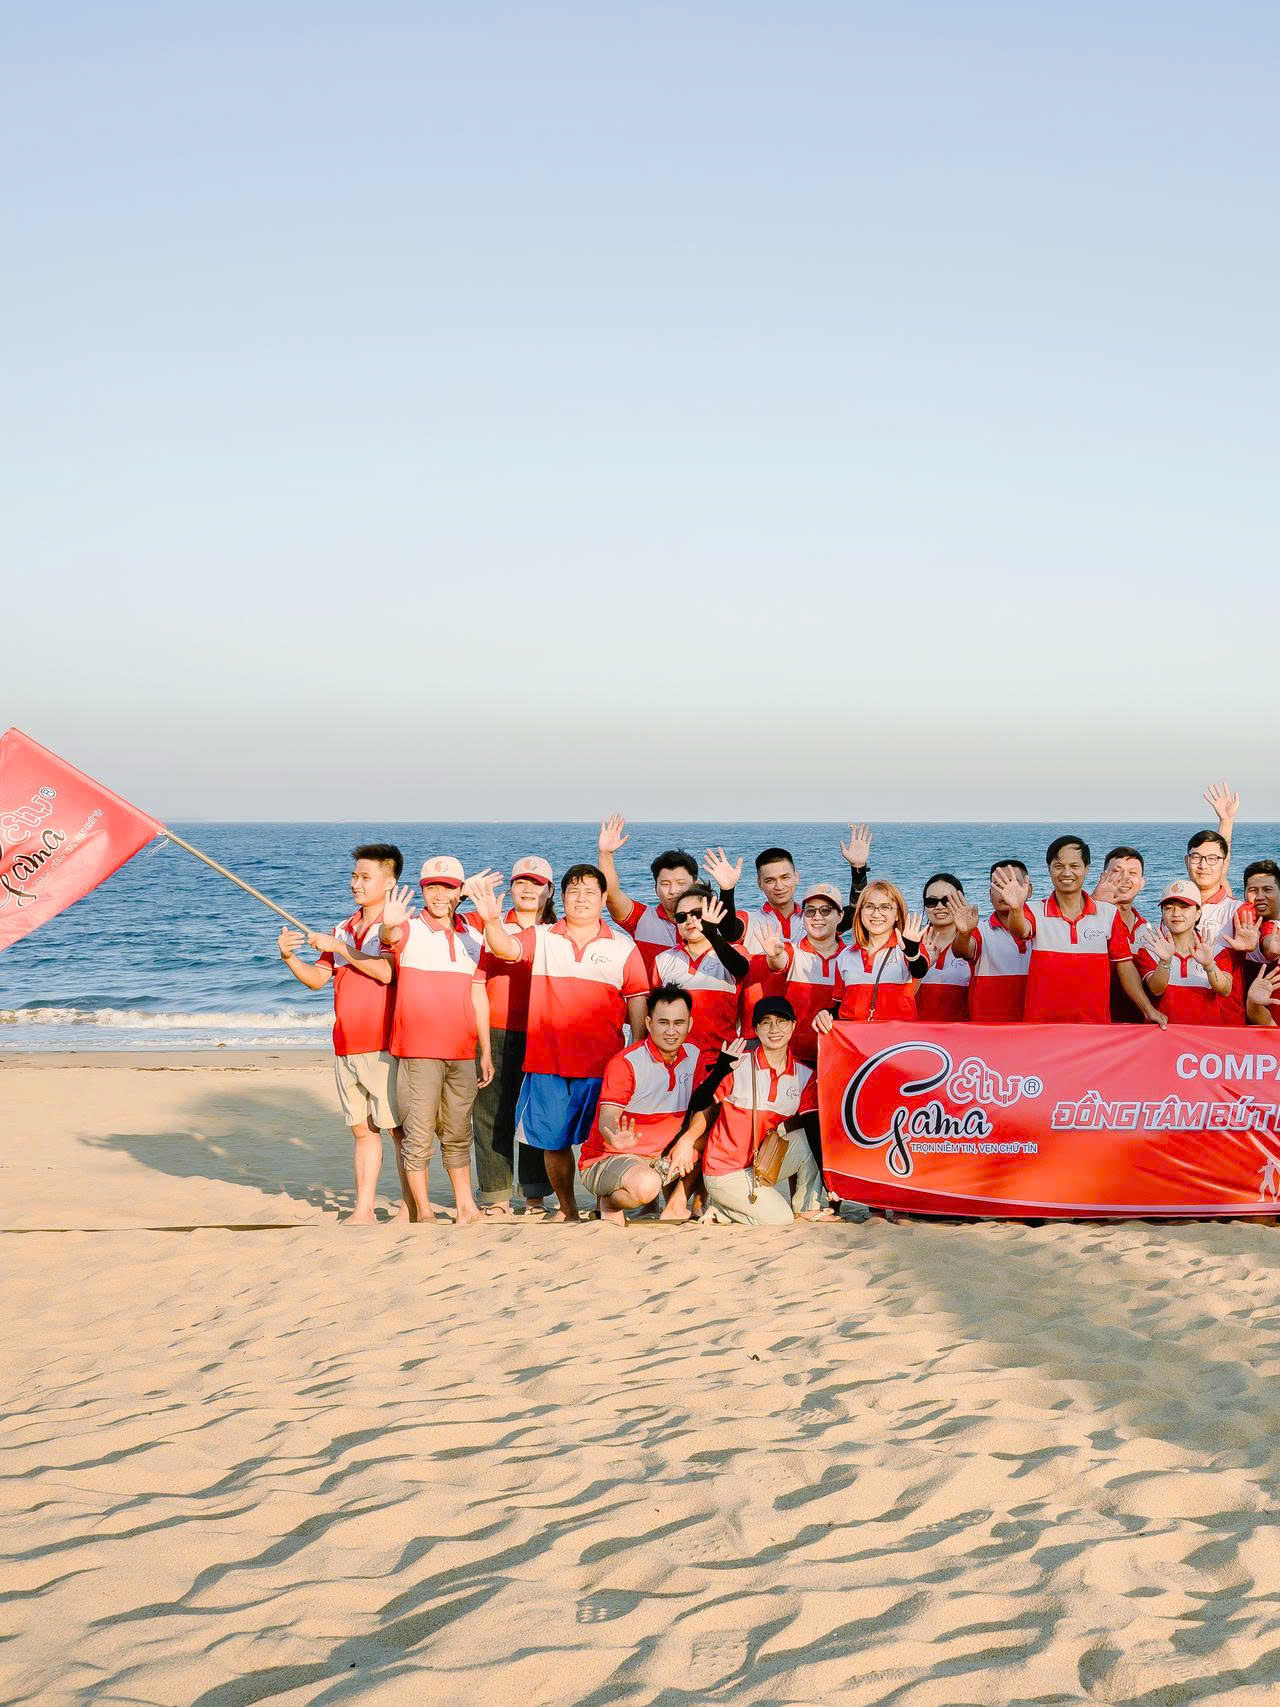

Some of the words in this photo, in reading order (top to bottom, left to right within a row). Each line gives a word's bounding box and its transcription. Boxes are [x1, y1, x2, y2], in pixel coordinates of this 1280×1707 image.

[841, 1040, 993, 1178] Gama
[1051, 1090, 1142, 1130] ĐỒNG
[1143, 1094, 1208, 1131] TÂM
[1206, 1095, 1276, 1132] BỨT
[911, 1142, 935, 1154] TRỌN
[961, 1142, 979, 1154] TIN,
